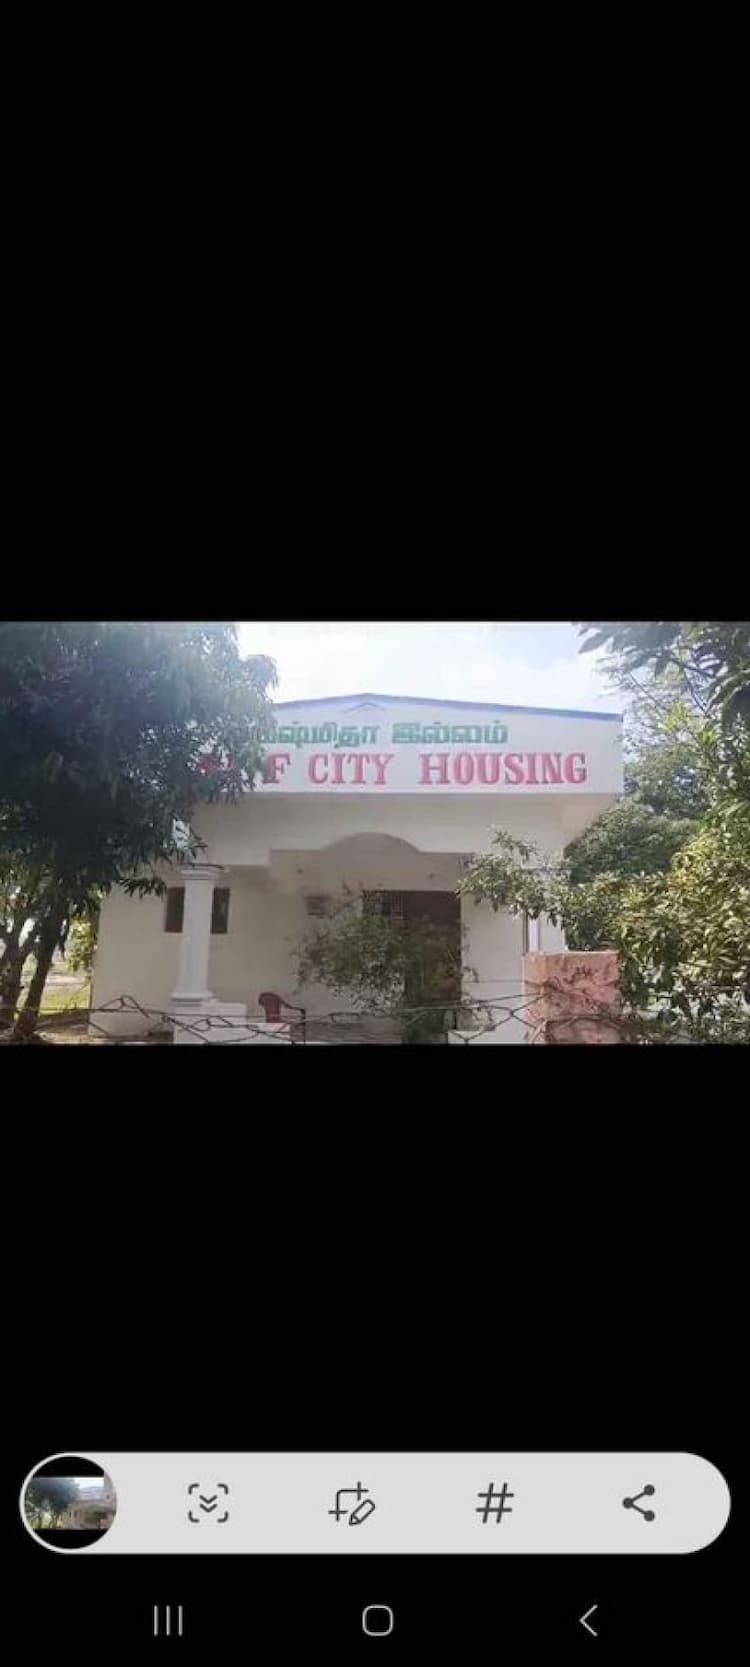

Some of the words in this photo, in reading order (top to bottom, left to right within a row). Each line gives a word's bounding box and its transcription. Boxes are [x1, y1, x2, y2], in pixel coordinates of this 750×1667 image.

[391, 719, 508, 744] இல்லம்
[307, 752, 394, 785] CITY
[418, 752, 588, 785] HOUSING
